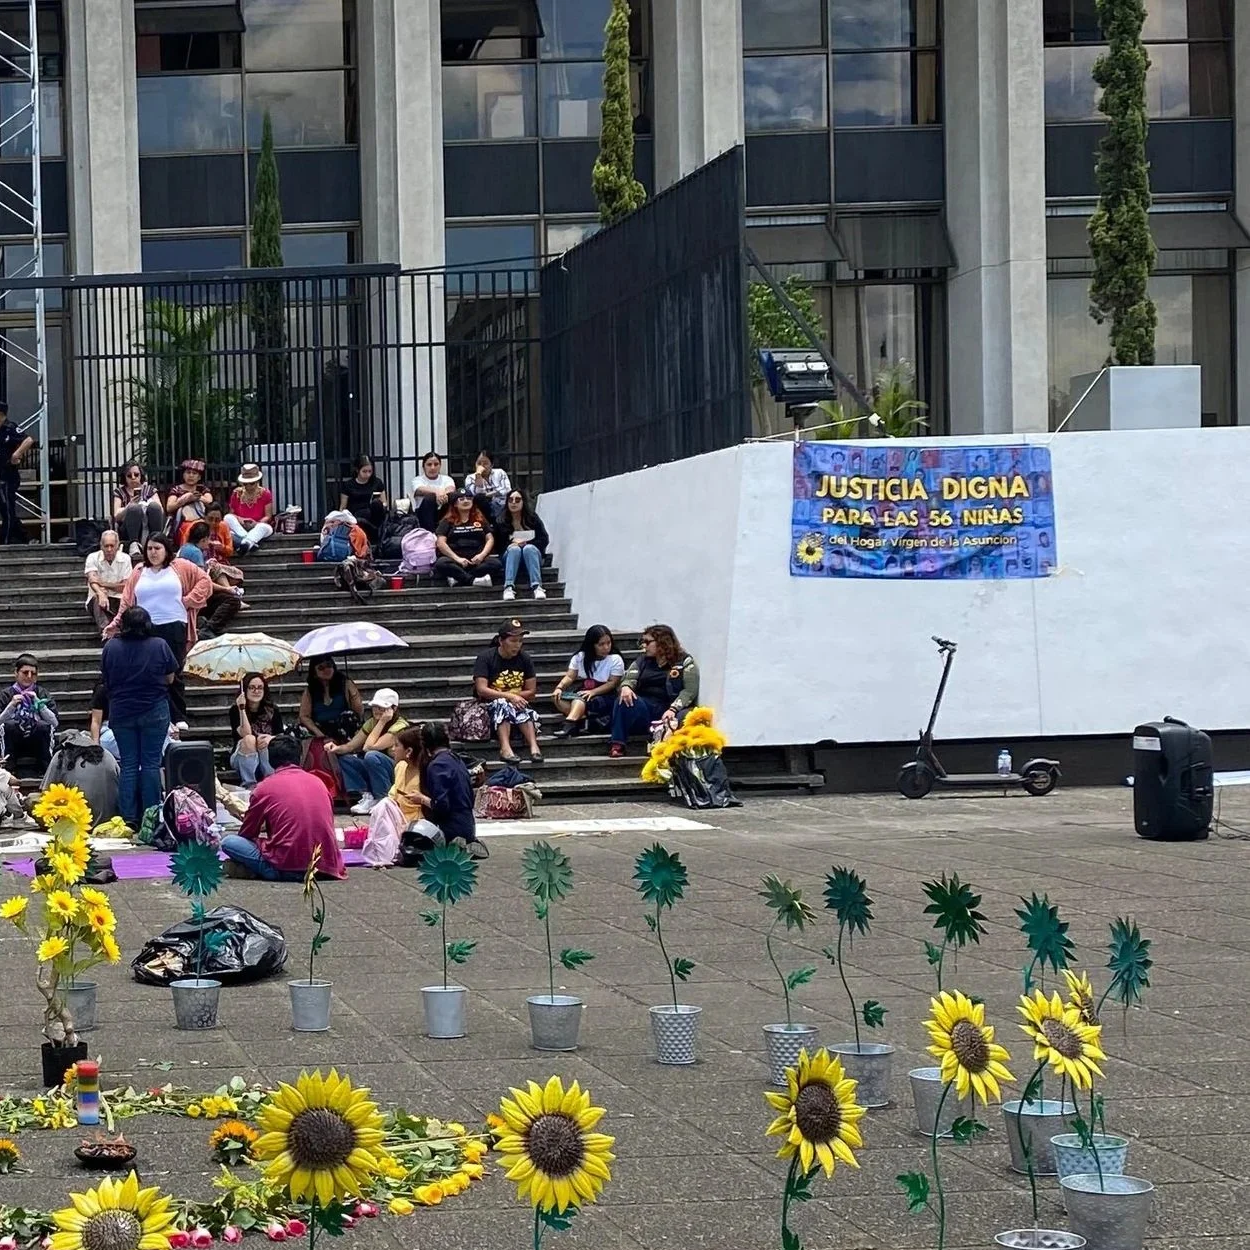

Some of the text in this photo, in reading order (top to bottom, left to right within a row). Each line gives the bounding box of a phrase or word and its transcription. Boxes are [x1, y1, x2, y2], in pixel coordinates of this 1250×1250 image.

[815, 474, 1030, 501] JUSTICIA DIGNA
[822, 504, 1024, 527] PARA LAS 56 NIÑAS
[829, 535, 847, 545] del
[850, 536, 886, 549] Hogar
[891, 537, 928, 549] Virgen
[931, 536, 947, 547] de
[949, 535, 960, 547] la
